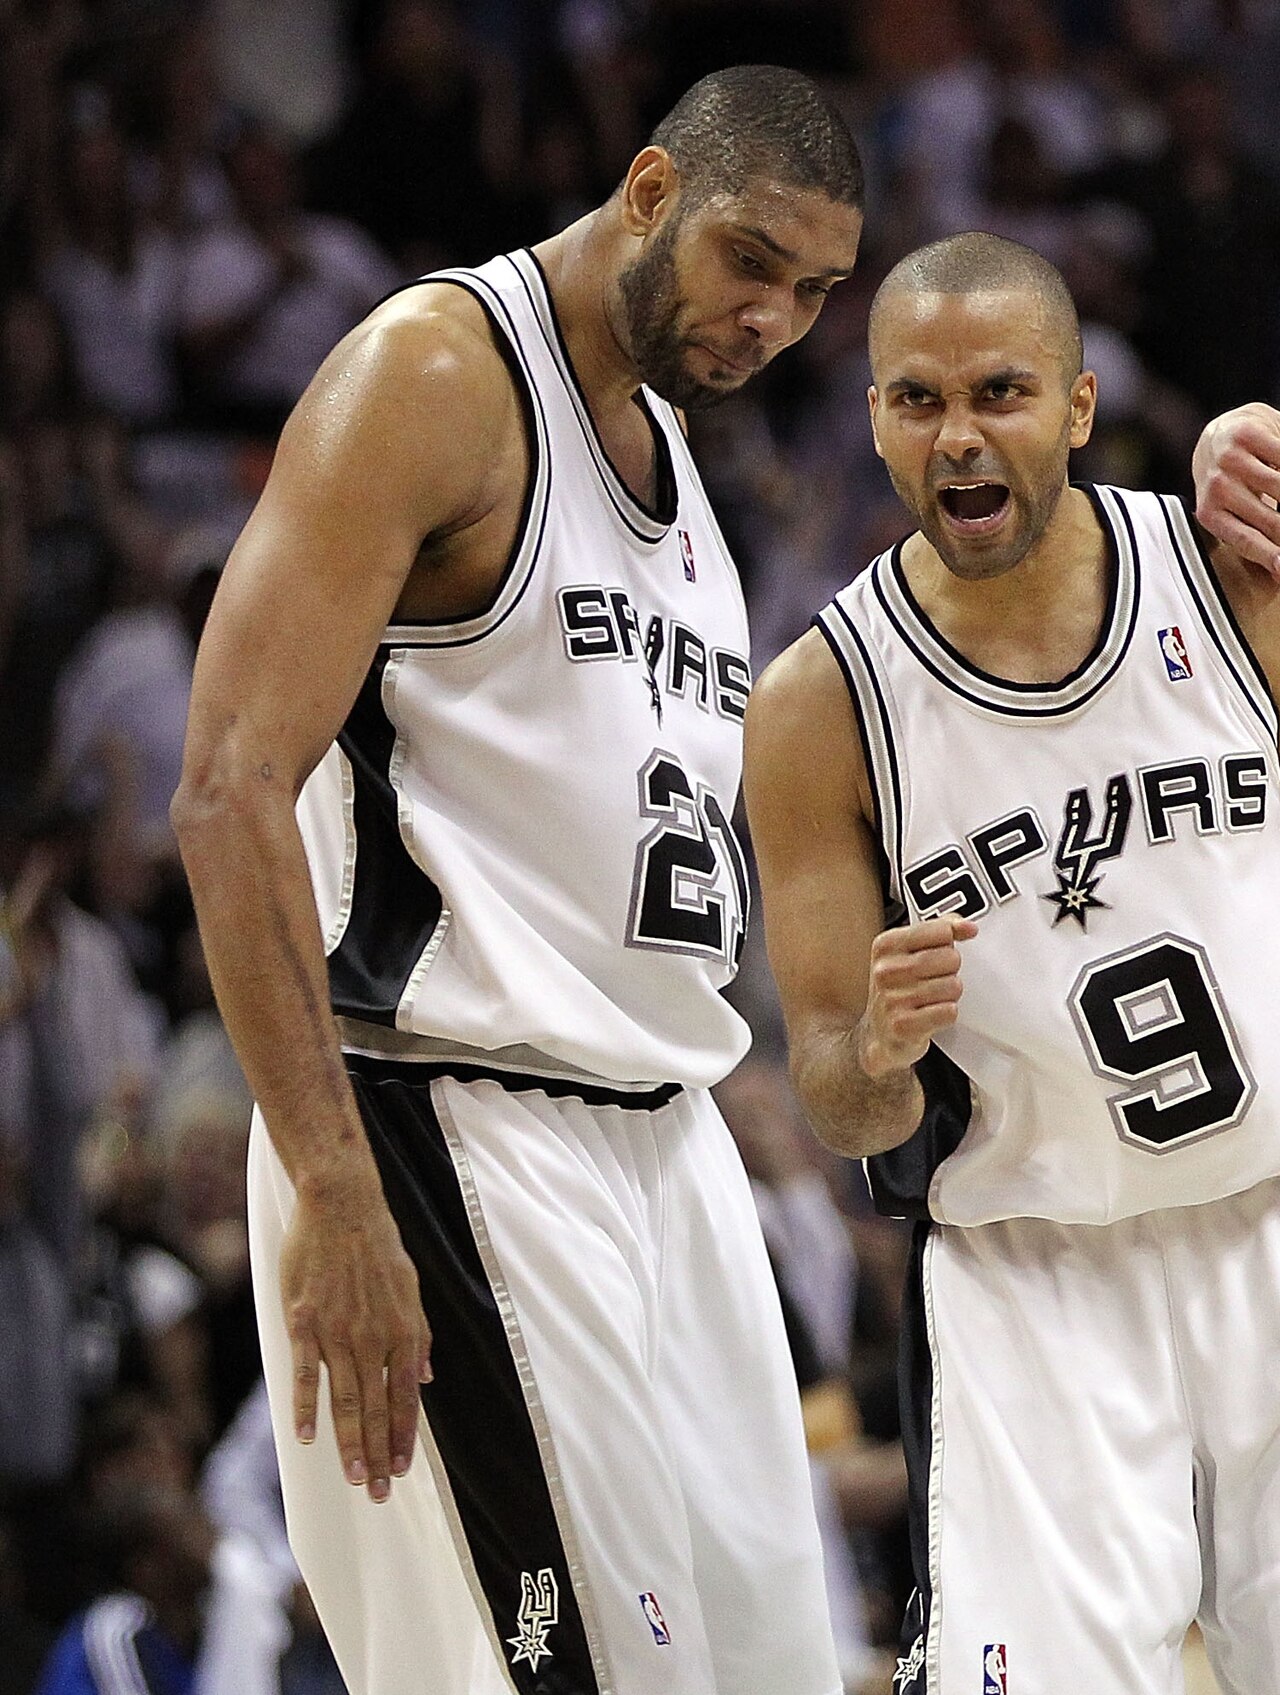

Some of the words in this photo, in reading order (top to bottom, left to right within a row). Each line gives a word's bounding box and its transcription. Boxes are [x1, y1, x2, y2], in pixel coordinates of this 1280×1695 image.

[624, 747, 750, 968] 21
[902, 751, 1269, 932] SPURS
[1066, 931, 1260, 1156] 9
